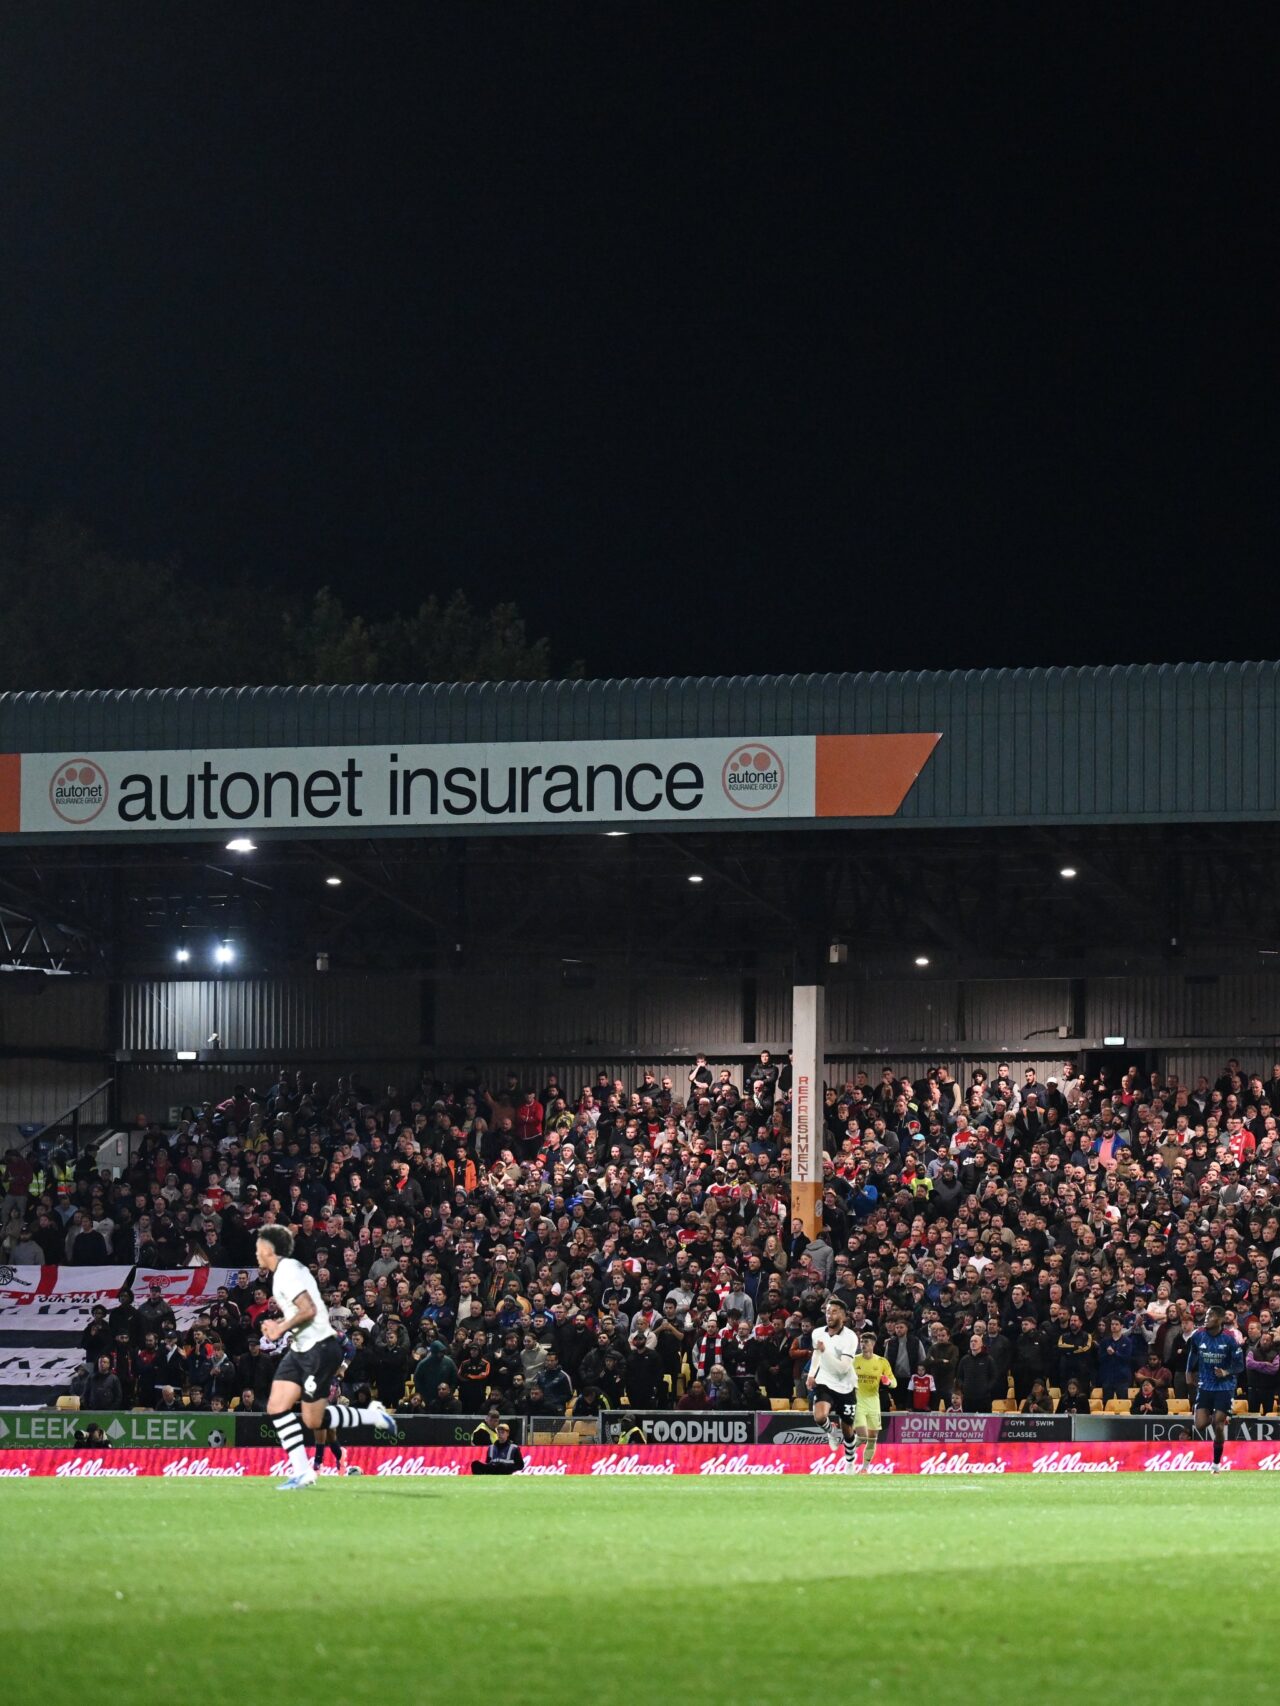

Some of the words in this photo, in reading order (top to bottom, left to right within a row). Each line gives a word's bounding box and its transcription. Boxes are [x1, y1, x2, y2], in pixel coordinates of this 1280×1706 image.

[728, 770, 778, 783] autonet
[56, 784, 102, 798] autonet
[118, 758, 363, 822] autonet
[389, 753, 704, 816] insurance
[729, 783, 758, 791] INSURANCE
[84, 796, 102, 804] GROUP
[304, 1375, 318, 1393] 6
[15, 1417, 80, 1439] LEEK
[131, 1418, 197, 1440] LEEK
[642, 1420, 749, 1443] FOODHUB
[901, 1418, 940, 1431] JOIN
[945, 1418, 987, 1431] NOW
